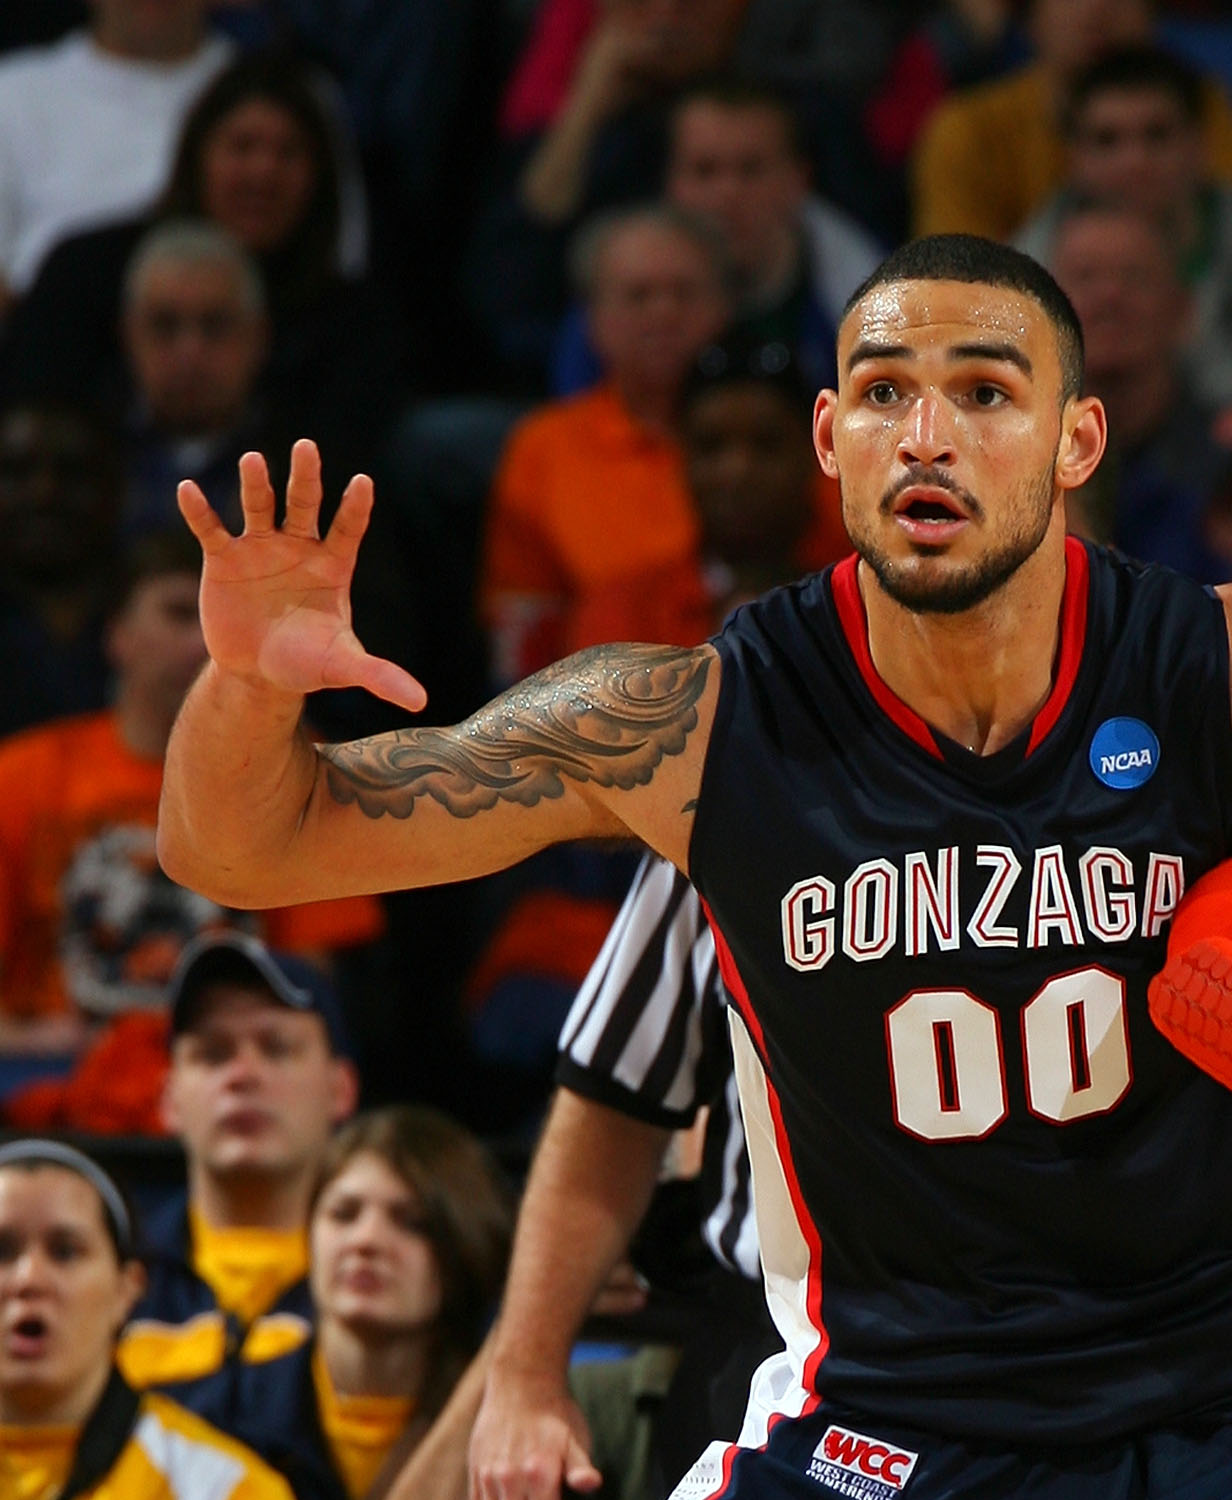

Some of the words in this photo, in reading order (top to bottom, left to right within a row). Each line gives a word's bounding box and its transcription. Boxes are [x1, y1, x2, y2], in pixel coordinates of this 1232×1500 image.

[1100, 748, 1152, 773] NCAA
[781, 845, 1185, 972] GONZAGA
[883, 963, 1133, 1144] 00
[810, 1459, 849, 1483] WEST
[851, 1475, 897, 1498] COAST
[824, 1429, 911, 1484] WCC
